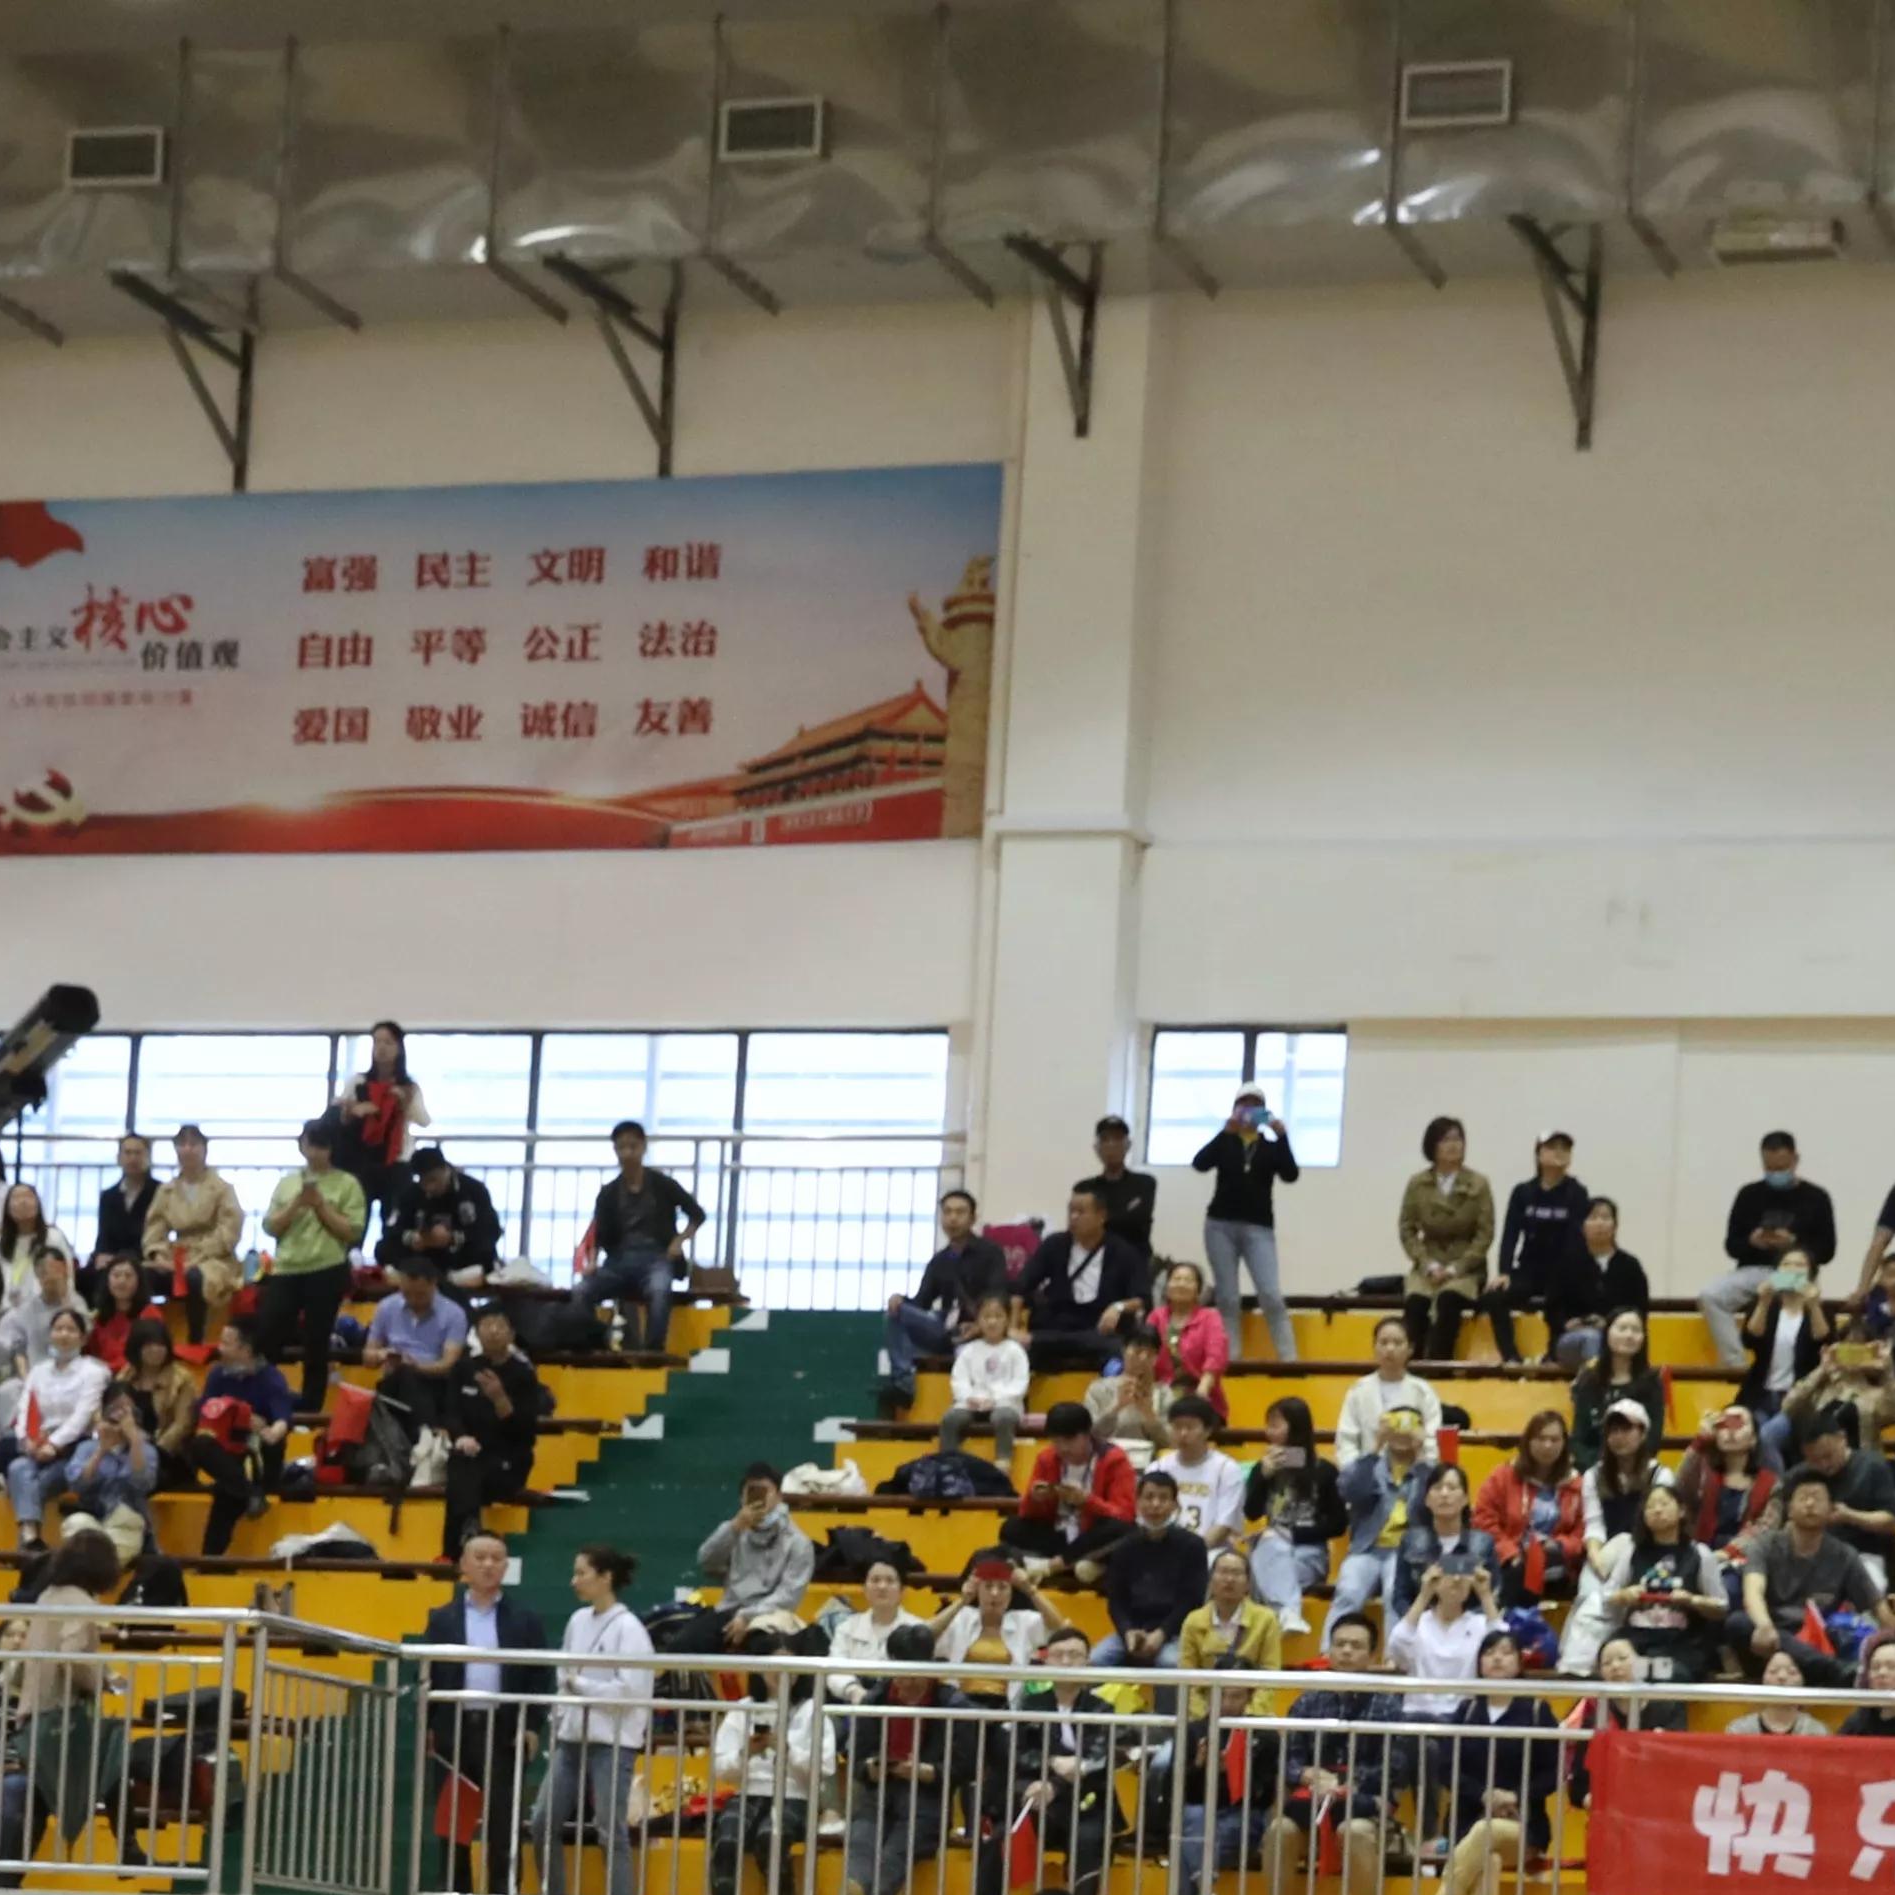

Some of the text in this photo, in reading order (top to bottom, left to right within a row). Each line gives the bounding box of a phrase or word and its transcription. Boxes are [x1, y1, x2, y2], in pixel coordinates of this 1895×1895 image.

[302, 542, 722, 593] 富强 民主 文明 和谐
[71, 581, 195, 653] 核心
[141, 639, 241, 673] 价值观
[298, 620, 718, 670] 自由 平等 公正 法治
[293, 697, 714, 745] 爱国 敬业 诚信 友善
